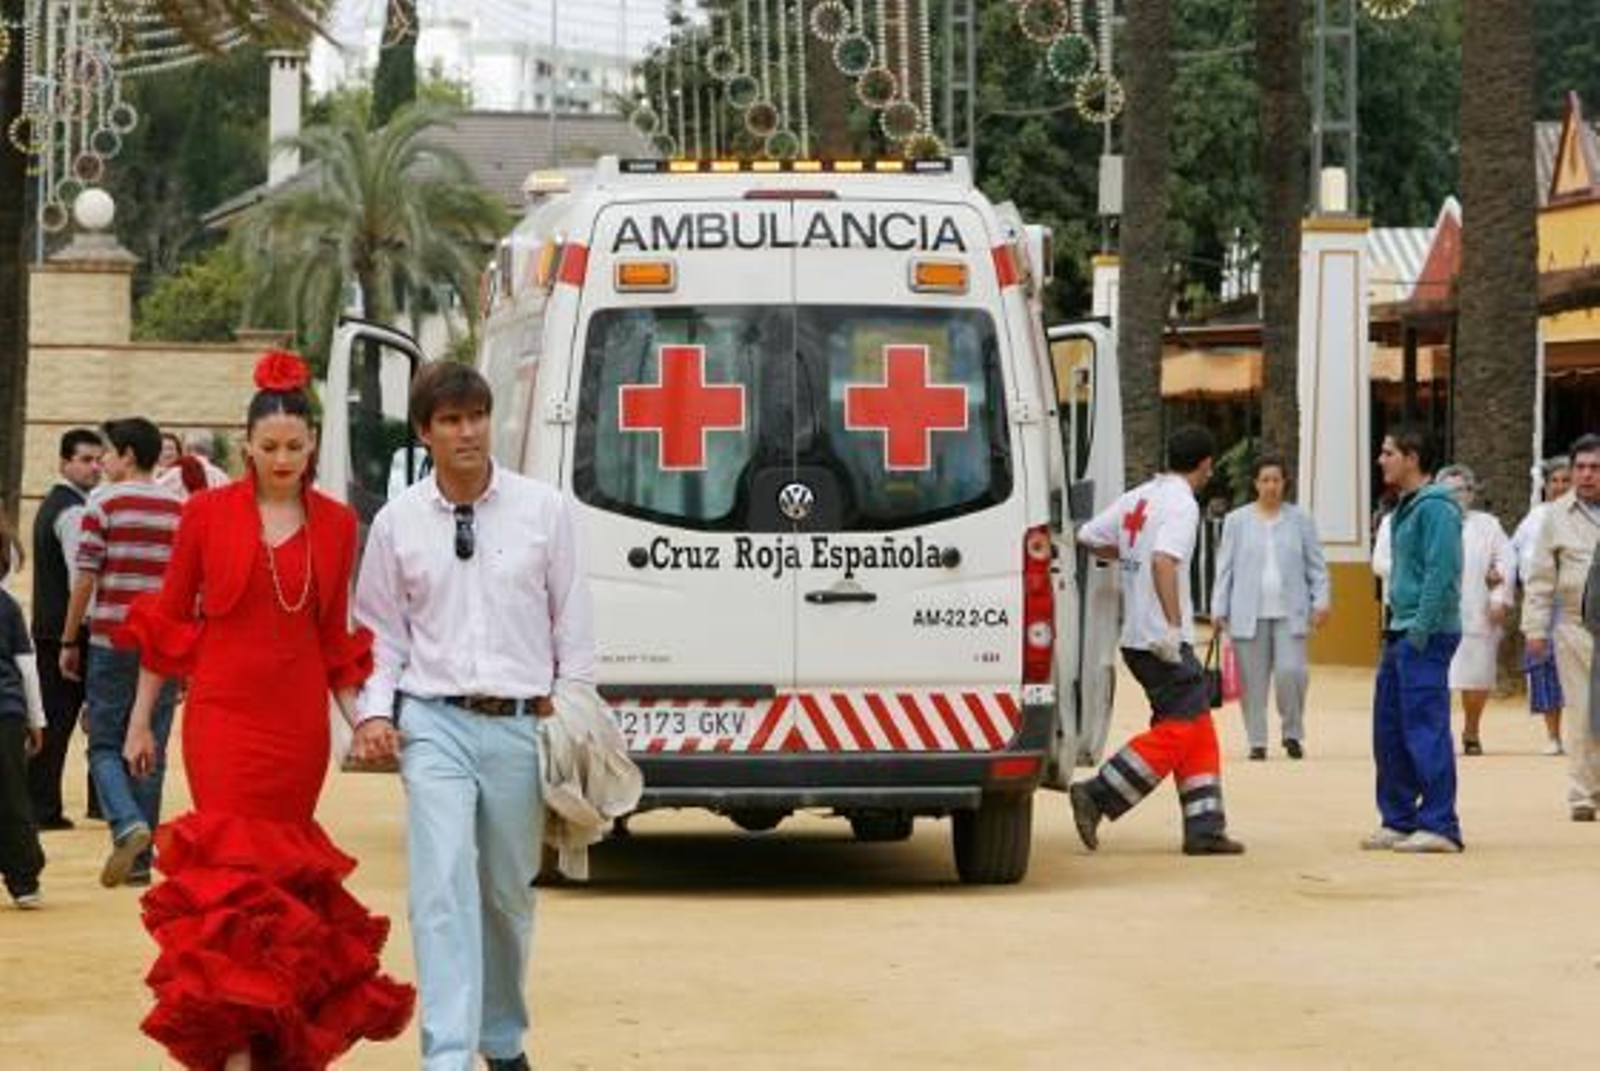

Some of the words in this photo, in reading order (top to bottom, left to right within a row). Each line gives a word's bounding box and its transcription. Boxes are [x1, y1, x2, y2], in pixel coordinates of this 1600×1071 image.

[612, 212, 966, 253] AMBULANCIA
[650, 536, 720, 569] Cruz
[734, 536, 801, 579] Roja
[811, 536, 942, 579] Española
[624, 711, 686, 734] 2173
[699, 711, 745, 734] GKV
